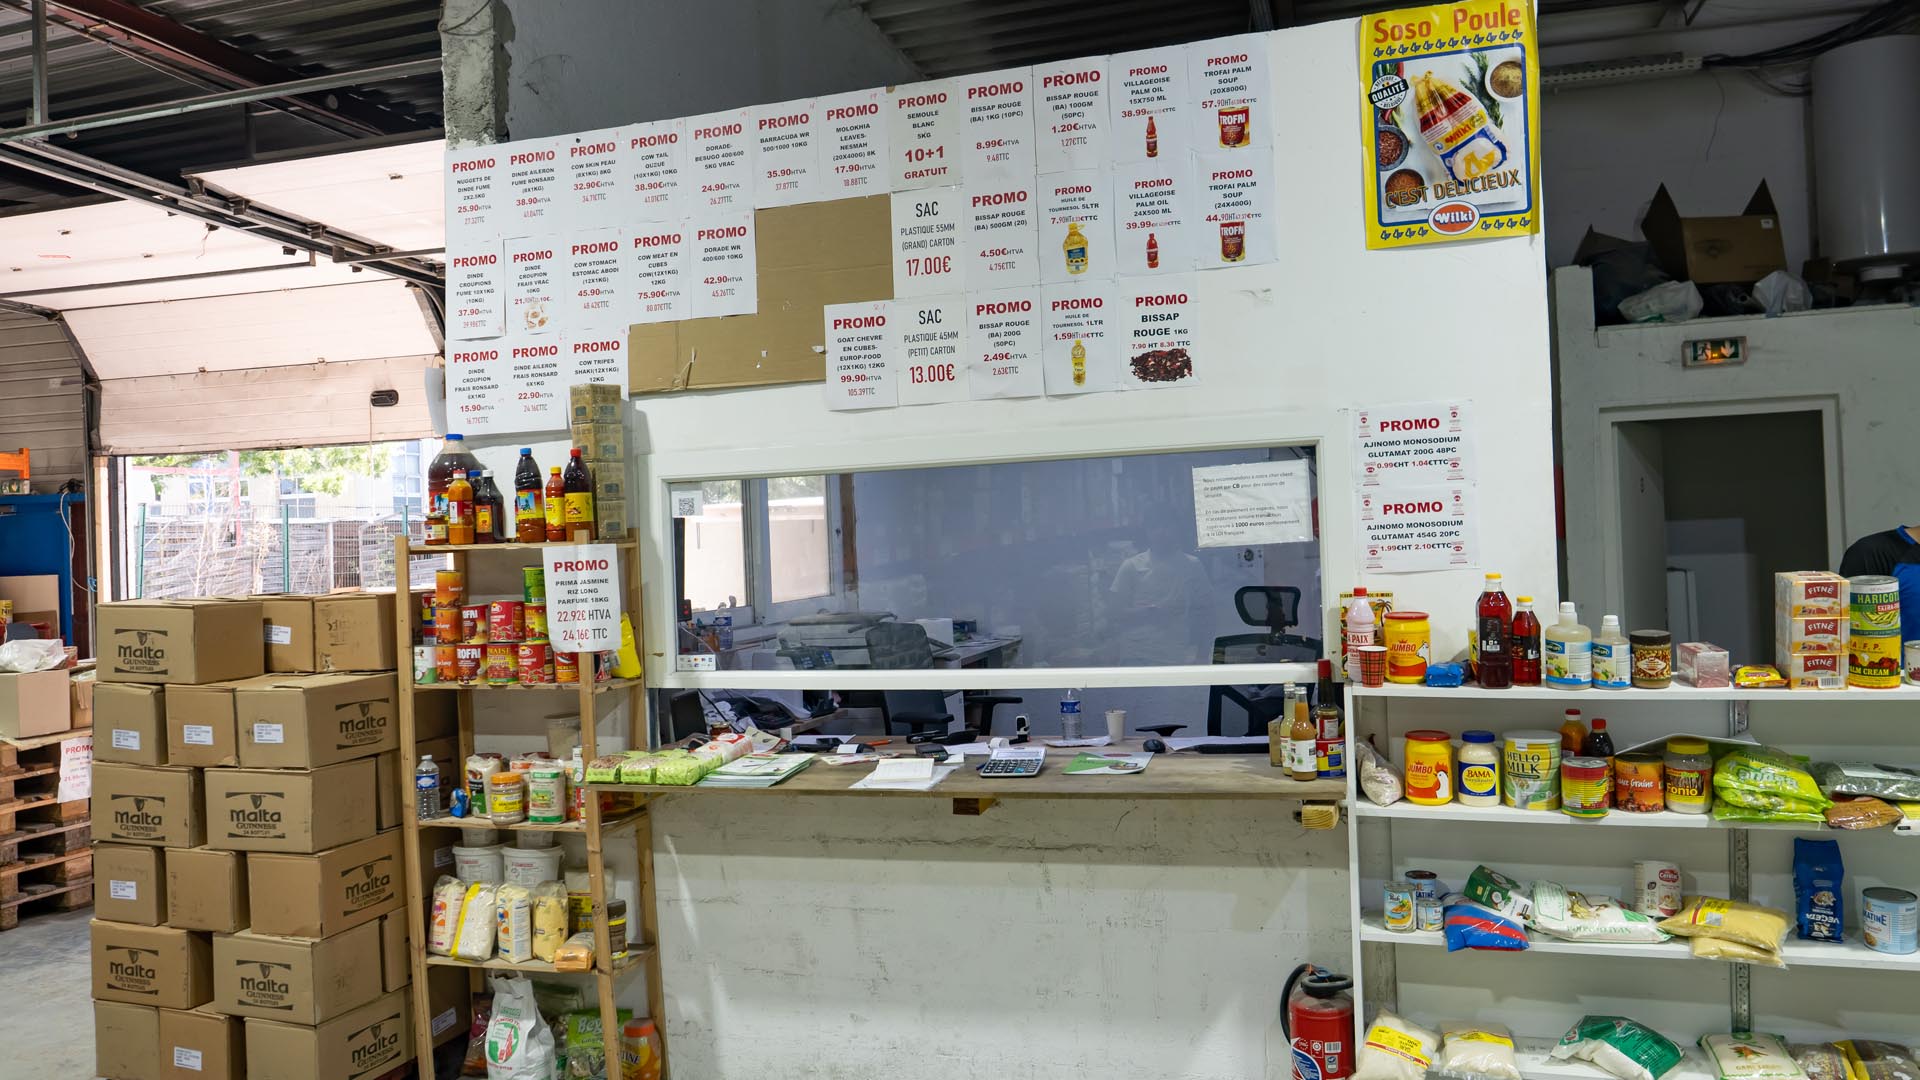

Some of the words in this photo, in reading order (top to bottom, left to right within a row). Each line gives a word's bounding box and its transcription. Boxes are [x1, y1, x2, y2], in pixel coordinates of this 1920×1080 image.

[1374, 18, 1432, 44] Soso
[1453, 2, 1522, 34] Poule
[1208, 54, 1248, 66] PROMO
[1130, 65, 1168, 76] PROMO
[1204, 69, 1230, 78] TROFAI
[1232, 66, 1252, 74] PALM
[1043, 70, 1100, 88] PROMO
[1124, 76, 1170, 88] VILLAGEOISE
[1218, 76, 1238, 84] SOUP
[968, 82, 1024, 99] PROMO
[1046, 94, 1072, 102] BISSAP
[1073, 90, 1098, 98] ROUGE
[1131, 87, 1150, 96] PALM
[898, 92, 948, 108] PROMO
[970, 104, 996, 112] BISSAP
[998, 101, 1022, 110] ROUGE
[826, 103, 878, 120] PROMO
[908, 110, 940, 120] SEMOULE
[758, 114, 810, 130] PROMO
[836, 122, 870, 132] MOLOKHIA
[912, 120, 934, 128] BLANC
[694, 123, 742, 140] PROMO
[918, 132, 932, 140] 5KG
[631, 133, 678, 150] PROMO
[570, 142, 616, 157] PROMO
[904, 146, 944, 162] 10+1
[510, 150, 556, 166] PROMO
[452, 158, 495, 172] PROMO
[904, 166, 948, 179] GRATUIT
[1212, 169, 1253, 181] PROMO
[1054, 185, 1092, 196] PROMO
[1134, 178, 1173, 190] PROMO
[1208, 183, 1235, 191] TROFAI
[1236, 181, 1257, 189] PALM
[1385, 183, 1429, 209] C'EST
[1434, 168, 1522, 201] DELICIEUX
[972, 190, 1028, 208] PROMO
[1128, 189, 1176, 200] VILLAGEOISE
[1222, 191, 1243, 199] SOUP
[915, 200, 939, 218] SAC
[1136, 200, 1155, 208] PALM
[975, 212, 1000, 222] BISSAP
[1002, 209, 1026, 218] ROUGE
[698, 226, 747, 240] PROMO
[900, 224, 934, 236] PLASTIQUE
[936, 222, 956, 233] 55MM
[634, 233, 682, 248] PROMO
[902, 240, 928, 252] (GRAND)
[929, 236, 955, 248] CARTON
[572, 241, 618, 256] PROMO
[704, 246, 729, 254] DORADE
[453, 254, 498, 268] PROMO
[513, 250, 553, 264] PROMO
[638, 252, 652, 260] COW
[652, 251, 668, 260] MEAT
[648, 260, 668, 268] CUBES
[906, 255, 952, 277] 17.00€
[1052, 297, 1104, 312] PROMO
[1135, 293, 1188, 308] PROMO
[976, 300, 1032, 316] PROMO
[833, 316, 886, 331] PROMO
[918, 308, 942, 326] SAC
[1141, 312, 1180, 323] BISSAP
[978, 321, 1004, 330] BISSAP
[1005, 320, 1030, 328] ROUGE
[837, 336, 855, 344] GOAT
[856, 334, 883, 342] CHEVRE
[904, 332, 938, 344] PLASTIQUE
[938, 330, 960, 341] 45MM
[988, 330, 1002, 340] (BA)
[1004, 330, 1022, 338] 200G
[1134, 327, 1170, 338] ROUGE
[573, 340, 620, 354] PROMO
[993, 340, 1016, 349] (50PC)
[454, 350, 498, 364] PROMO
[512, 345, 558, 358] PROMO
[908, 347, 929, 359] (PETIT)
[930, 345, 956, 356] CARTON
[909, 363, 956, 384] 13.00€
[1380, 418, 1440, 432] PROMO
[1364, 440, 1400, 448] AJINOMO
[1402, 436, 1460, 446] MONOSODIUM
[1368, 450, 1410, 458] GLUTAMAT
[1414, 448, 1434, 456] 200G
[1436, 446, 1457, 454] 48PC
[1383, 501, 1443, 516] PROMO
[1366, 523, 1404, 532] AJINOMO
[1406, 520, 1464, 529] MONOSODIUM
[1371, 532, 1414, 542] GLUTAMAT
[1416, 531, 1437, 539] 454G
[1438, 530, 1460, 538] 20PC
[554, 560, 608, 572] PROMO
[557, 610, 586, 622] 22.92€
[588, 609, 612, 620] HTVA
[562, 629, 590, 641] 24.16€
[592, 628, 608, 640] TTC
[1390, 644, 1416, 652] JUMBO
[1863, 668, 1890, 676] CREAM
[1507, 752, 1540, 763] HELLO
[1408, 764, 1433, 774] JUMBO
[1466, 769, 1491, 778] BAMA
[1507, 760, 1540, 774] MILK
[1666, 784, 1698, 796] Fonio
